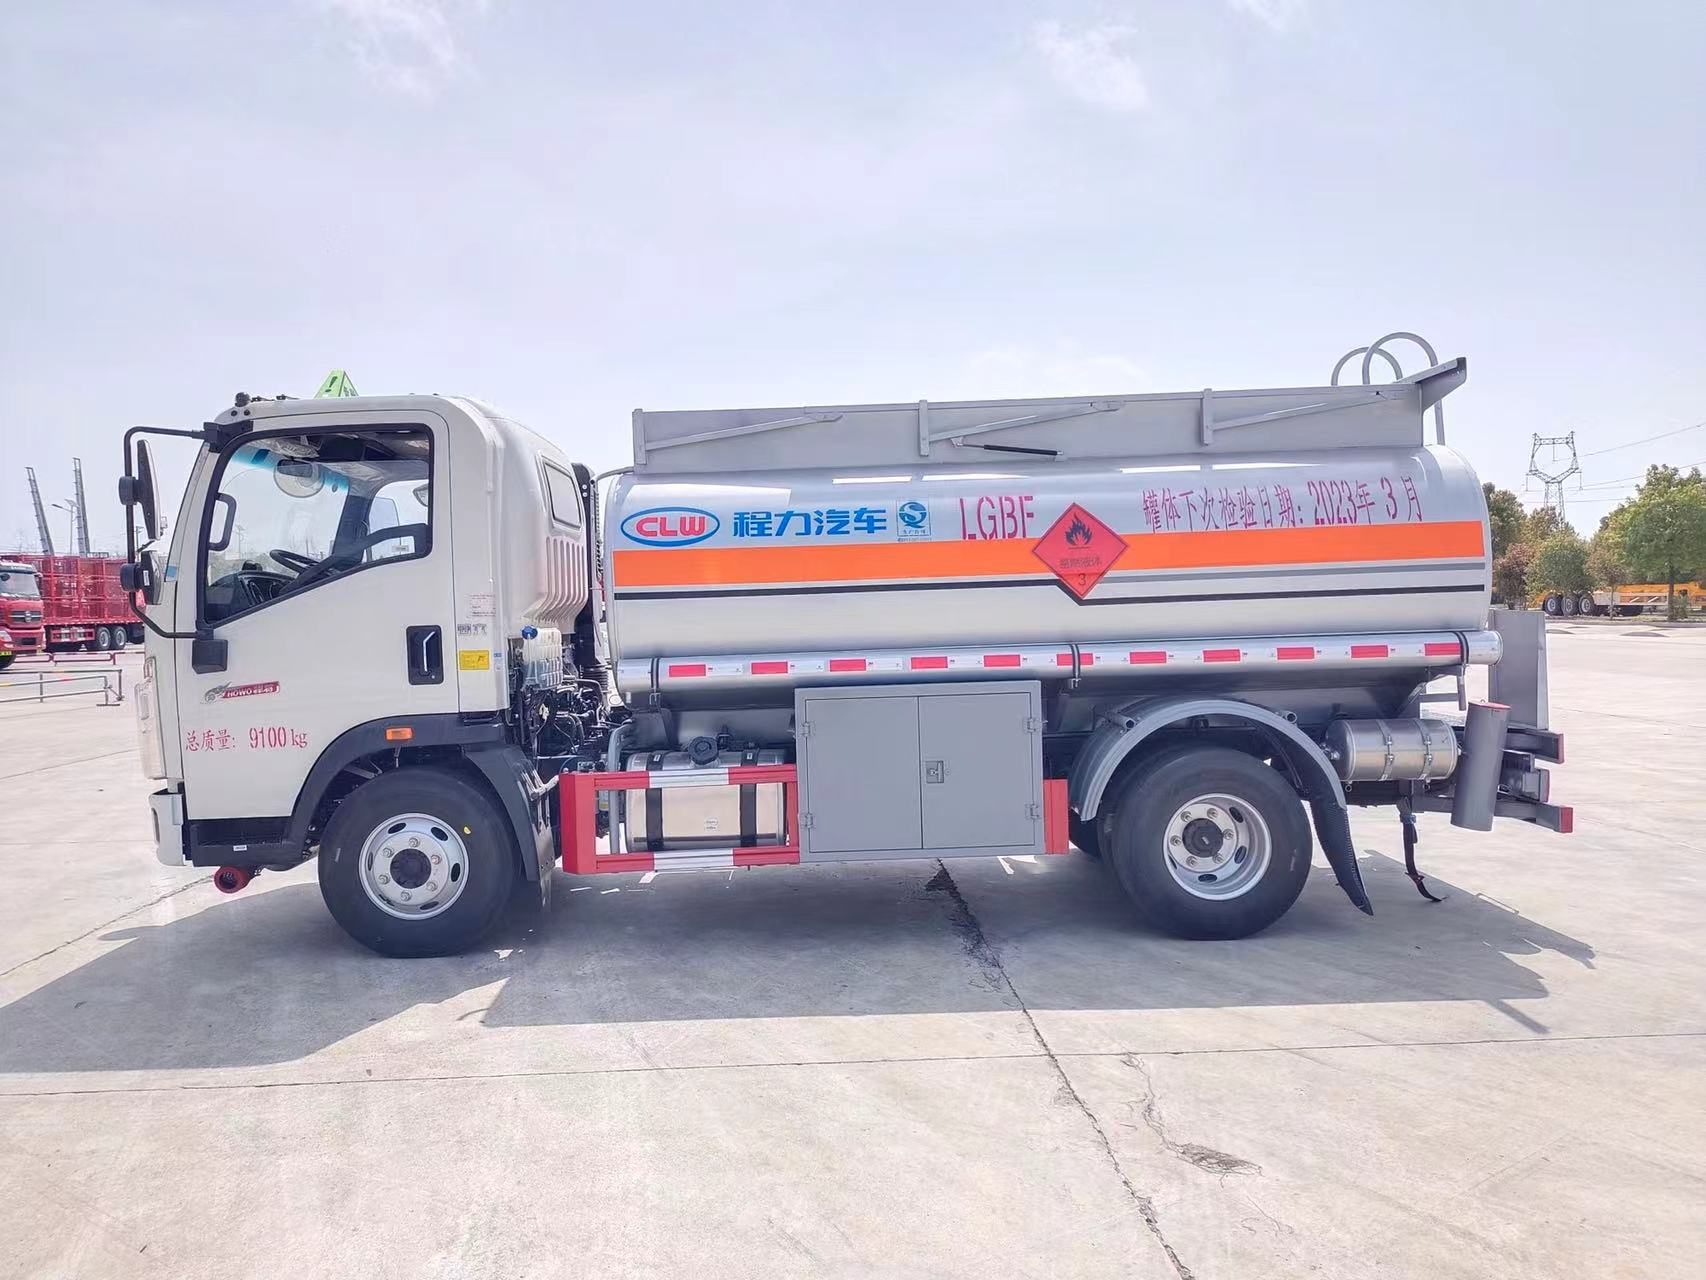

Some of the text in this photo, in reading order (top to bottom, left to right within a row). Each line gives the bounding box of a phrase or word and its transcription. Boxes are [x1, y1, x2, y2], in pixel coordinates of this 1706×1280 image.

[636, 517, 707, 537] CLW
[733, 507, 887, 537] 程力汽车
[960, 495, 1034, 540] LGBF
[1079, 573, 1087, 586] 3
